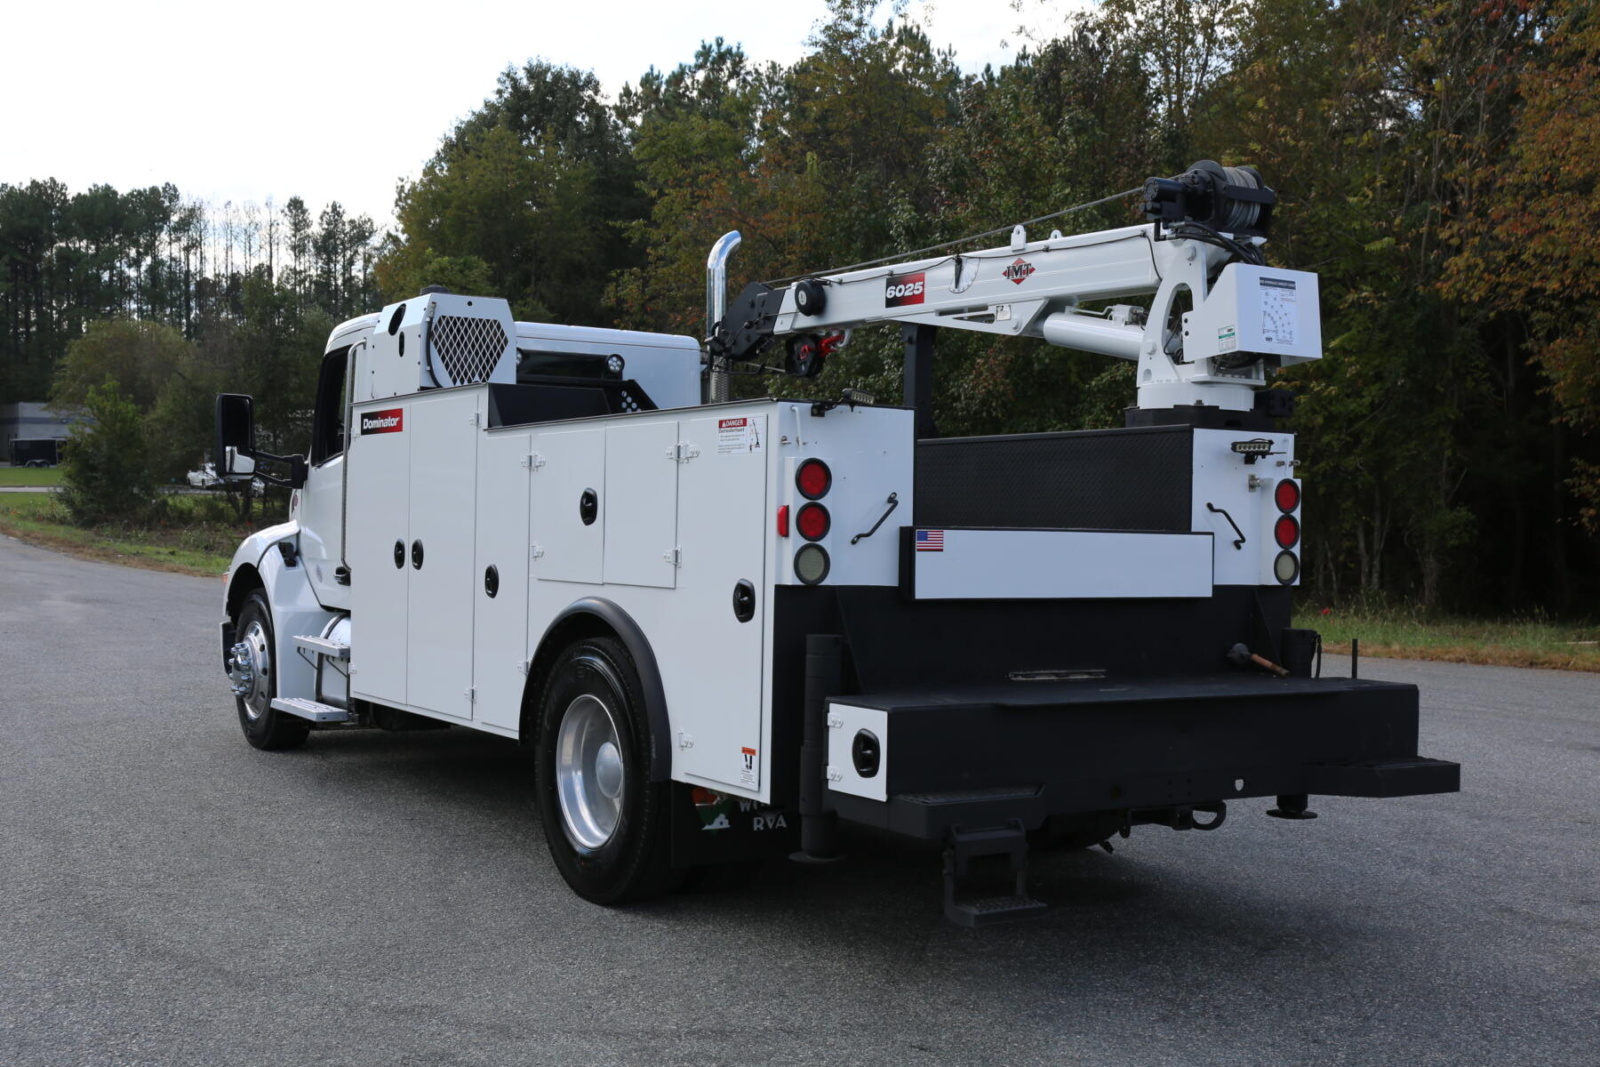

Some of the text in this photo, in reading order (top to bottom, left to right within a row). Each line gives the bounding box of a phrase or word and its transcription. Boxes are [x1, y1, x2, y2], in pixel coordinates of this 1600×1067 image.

[1006, 263, 1032, 280] IMT
[886, 281, 924, 299] 6025
[363, 416, 400, 430] Dominator
[725, 419, 743, 427] DANGER
[753, 815, 787, 831] RVA
